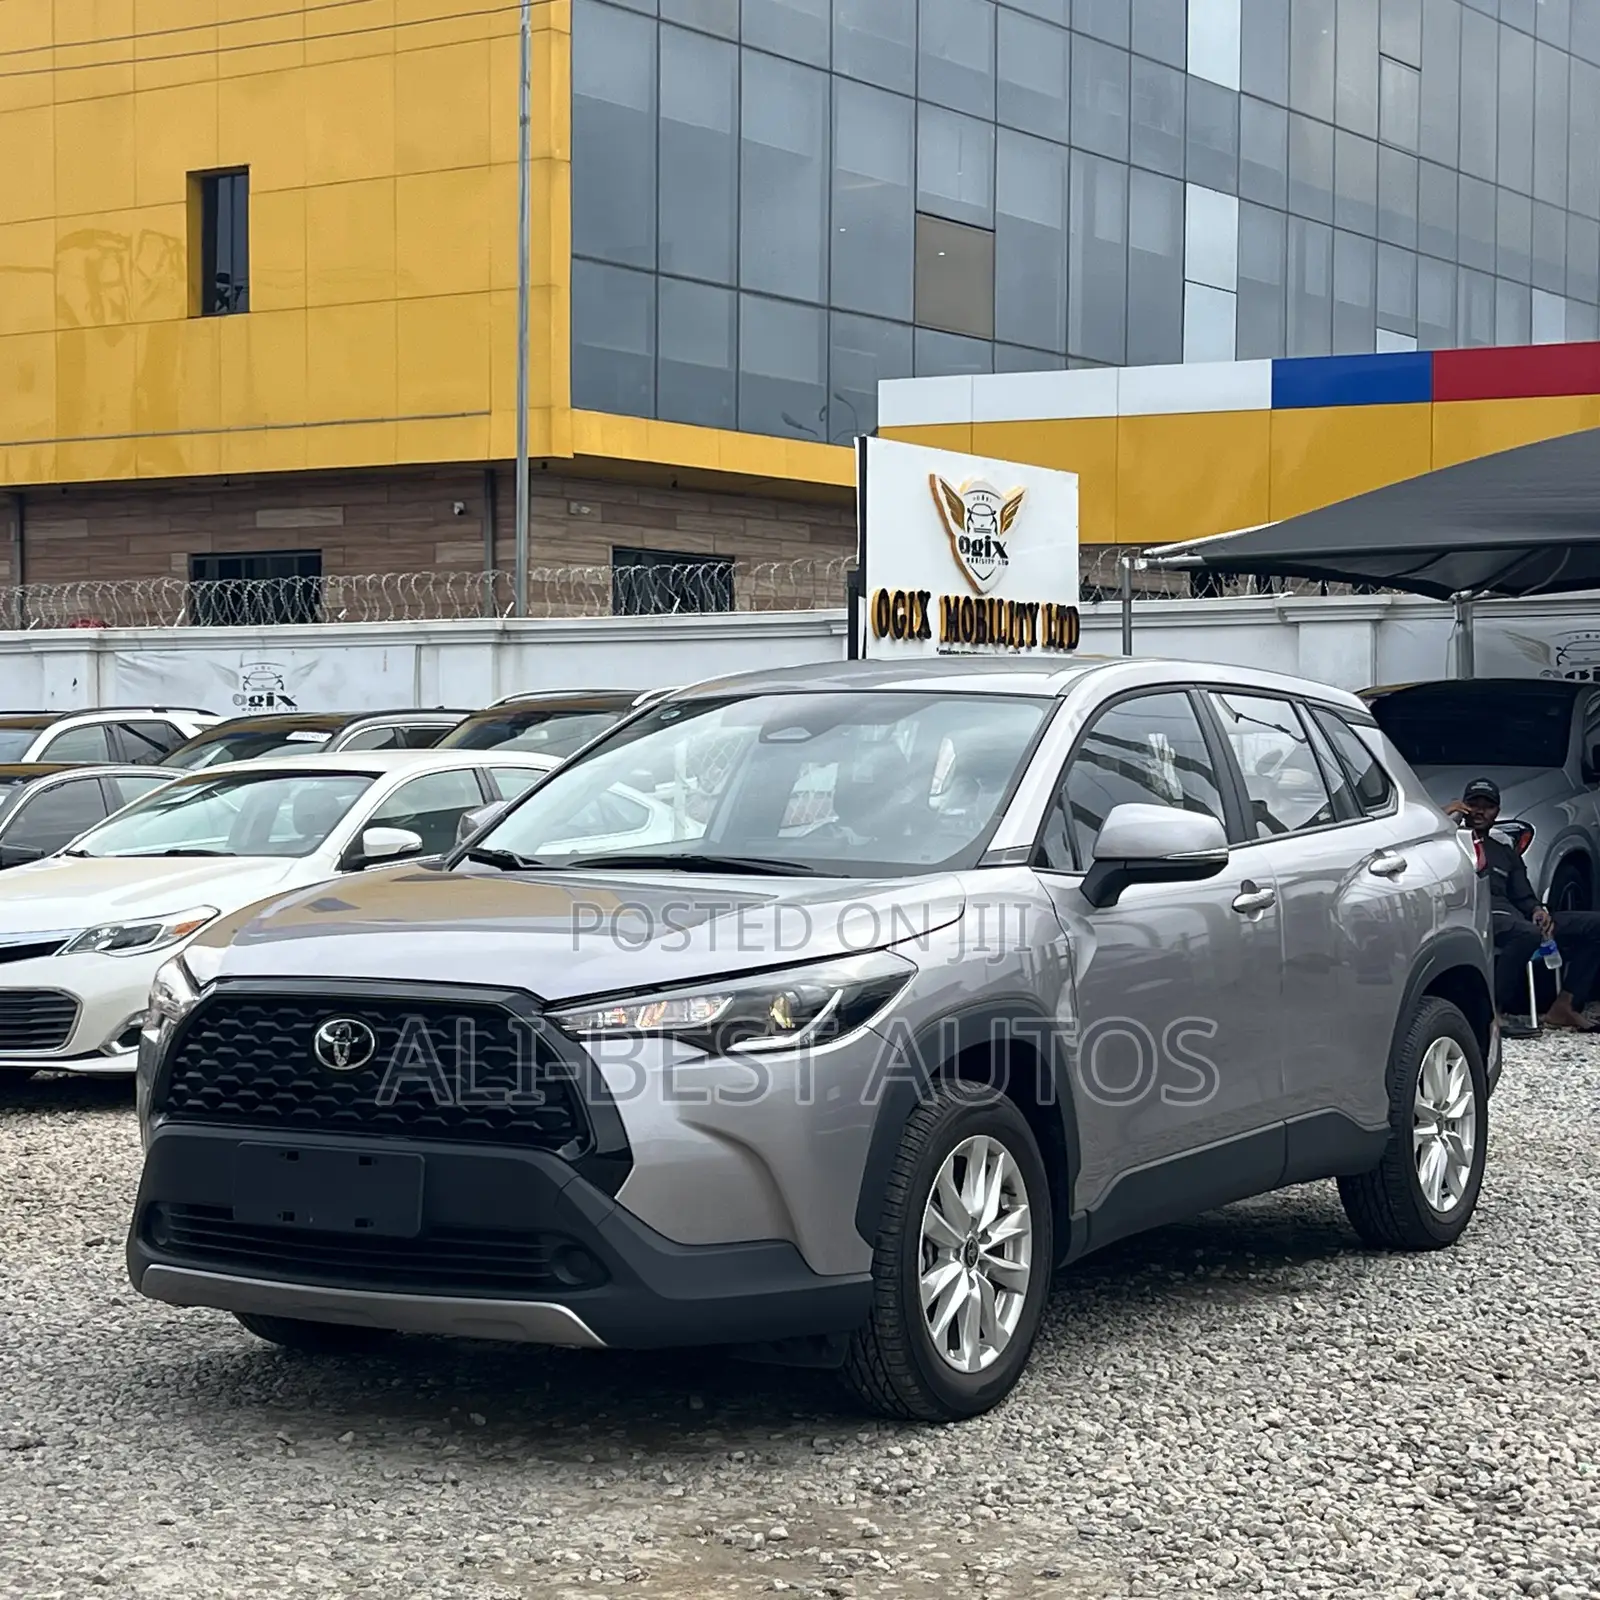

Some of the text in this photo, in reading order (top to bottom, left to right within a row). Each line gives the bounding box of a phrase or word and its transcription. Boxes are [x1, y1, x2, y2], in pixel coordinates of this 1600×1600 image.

[871, 588, 1080, 650] OGIX MOBILITY LTD
